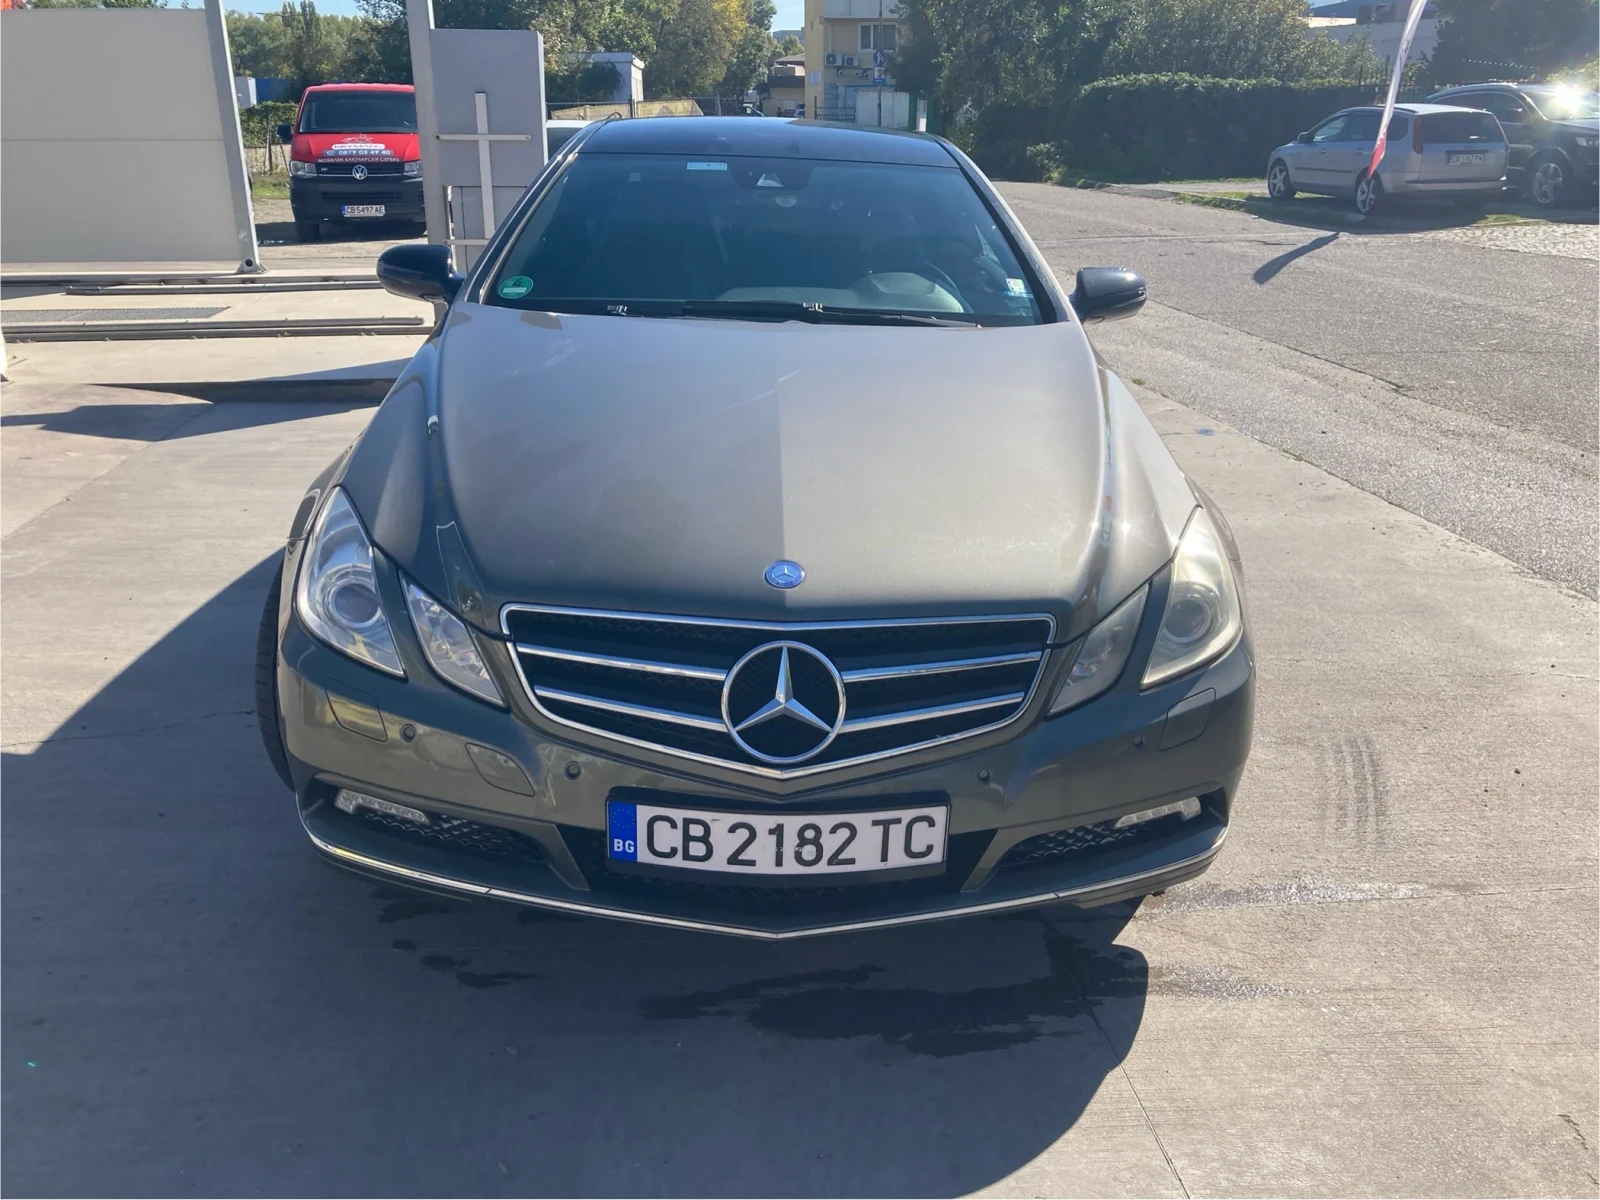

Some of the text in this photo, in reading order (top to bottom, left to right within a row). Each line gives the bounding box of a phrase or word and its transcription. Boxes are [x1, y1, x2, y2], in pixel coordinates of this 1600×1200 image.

[346, 206, 356, 214] CB
[374, 205, 384, 213] AE
[613, 838, 635, 853] BG
[646, 814, 936, 868] CB 2182 TC
